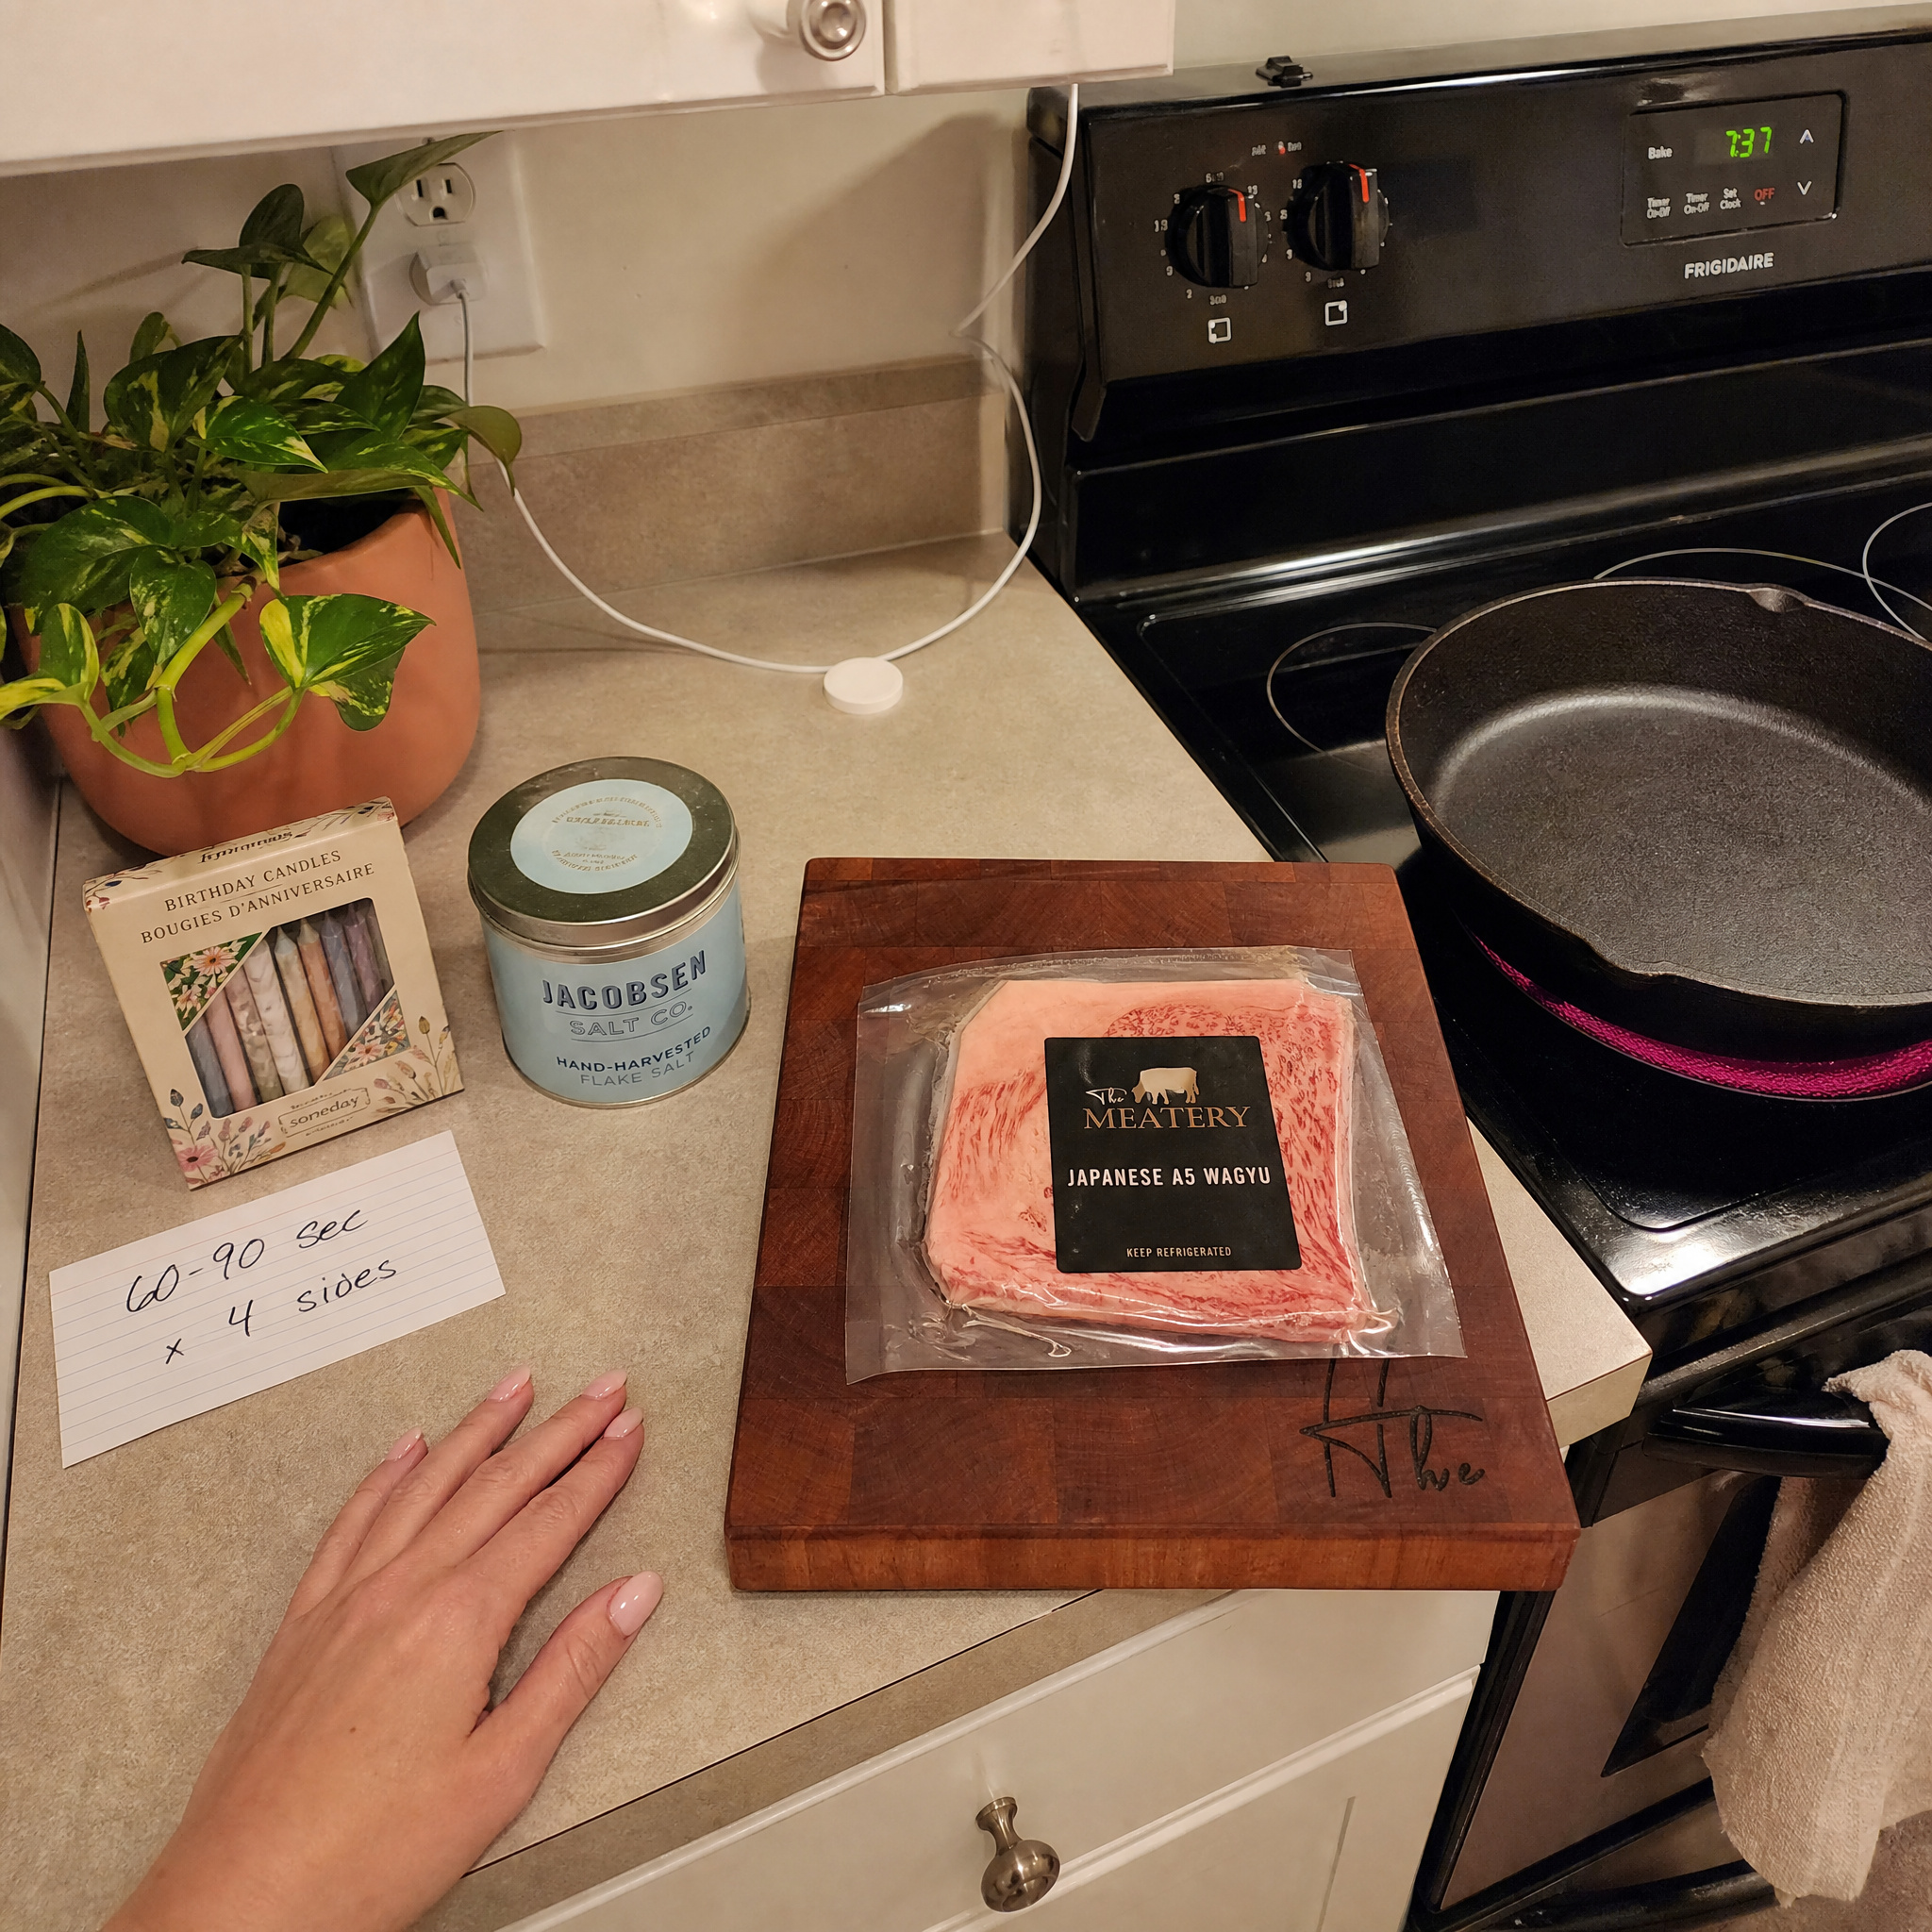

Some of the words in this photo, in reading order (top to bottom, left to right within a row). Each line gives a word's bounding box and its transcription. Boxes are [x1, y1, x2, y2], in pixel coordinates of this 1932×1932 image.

[1648, 146, 1673, 159] Bake
[1725, 126, 1773, 158] 7:37
[1720, 198, 1741, 209] Clock
[1755, 187, 1775, 201] OFF
[1684, 252, 1774, 279] FRIGIDAIRE
[163, 874, 256, 912] BIRTHDAY
[263, 850, 341, 883] CANDLES
[141, 909, 223, 944] BOUGIES
[229, 862, 375, 919] D'ANNIVERSAIRE
[541, 949, 707, 1010] JACOBSEN
[569, 1017, 640, 1037] SALT
[650, 1000, 693, 1026] CO.
[557, 1025, 711, 1073] HAND-HARVESTED
[580, 1072, 642, 1087] FLAKE
[651, 1050, 695, 1078] SALT
[1086, 1087, 1127, 1105] The
[1083, 1106, 1251, 1129] MEATERY
[1067, 1168, 1164, 1187] JAPANESE
[1172, 1168, 1196, 1186] A5
[1203, 1166, 1271, 1185] WAGYU
[125, 1238, 265, 1313] 60-90
[296, 1209, 368, 1249] sec
[1126, 1247, 1153, 1257] KEEP
[1157, 1246, 1232, 1257] REFRIGERATED
[228, 1299, 254, 1337] 4
[296, 1259, 397, 1313] sides
